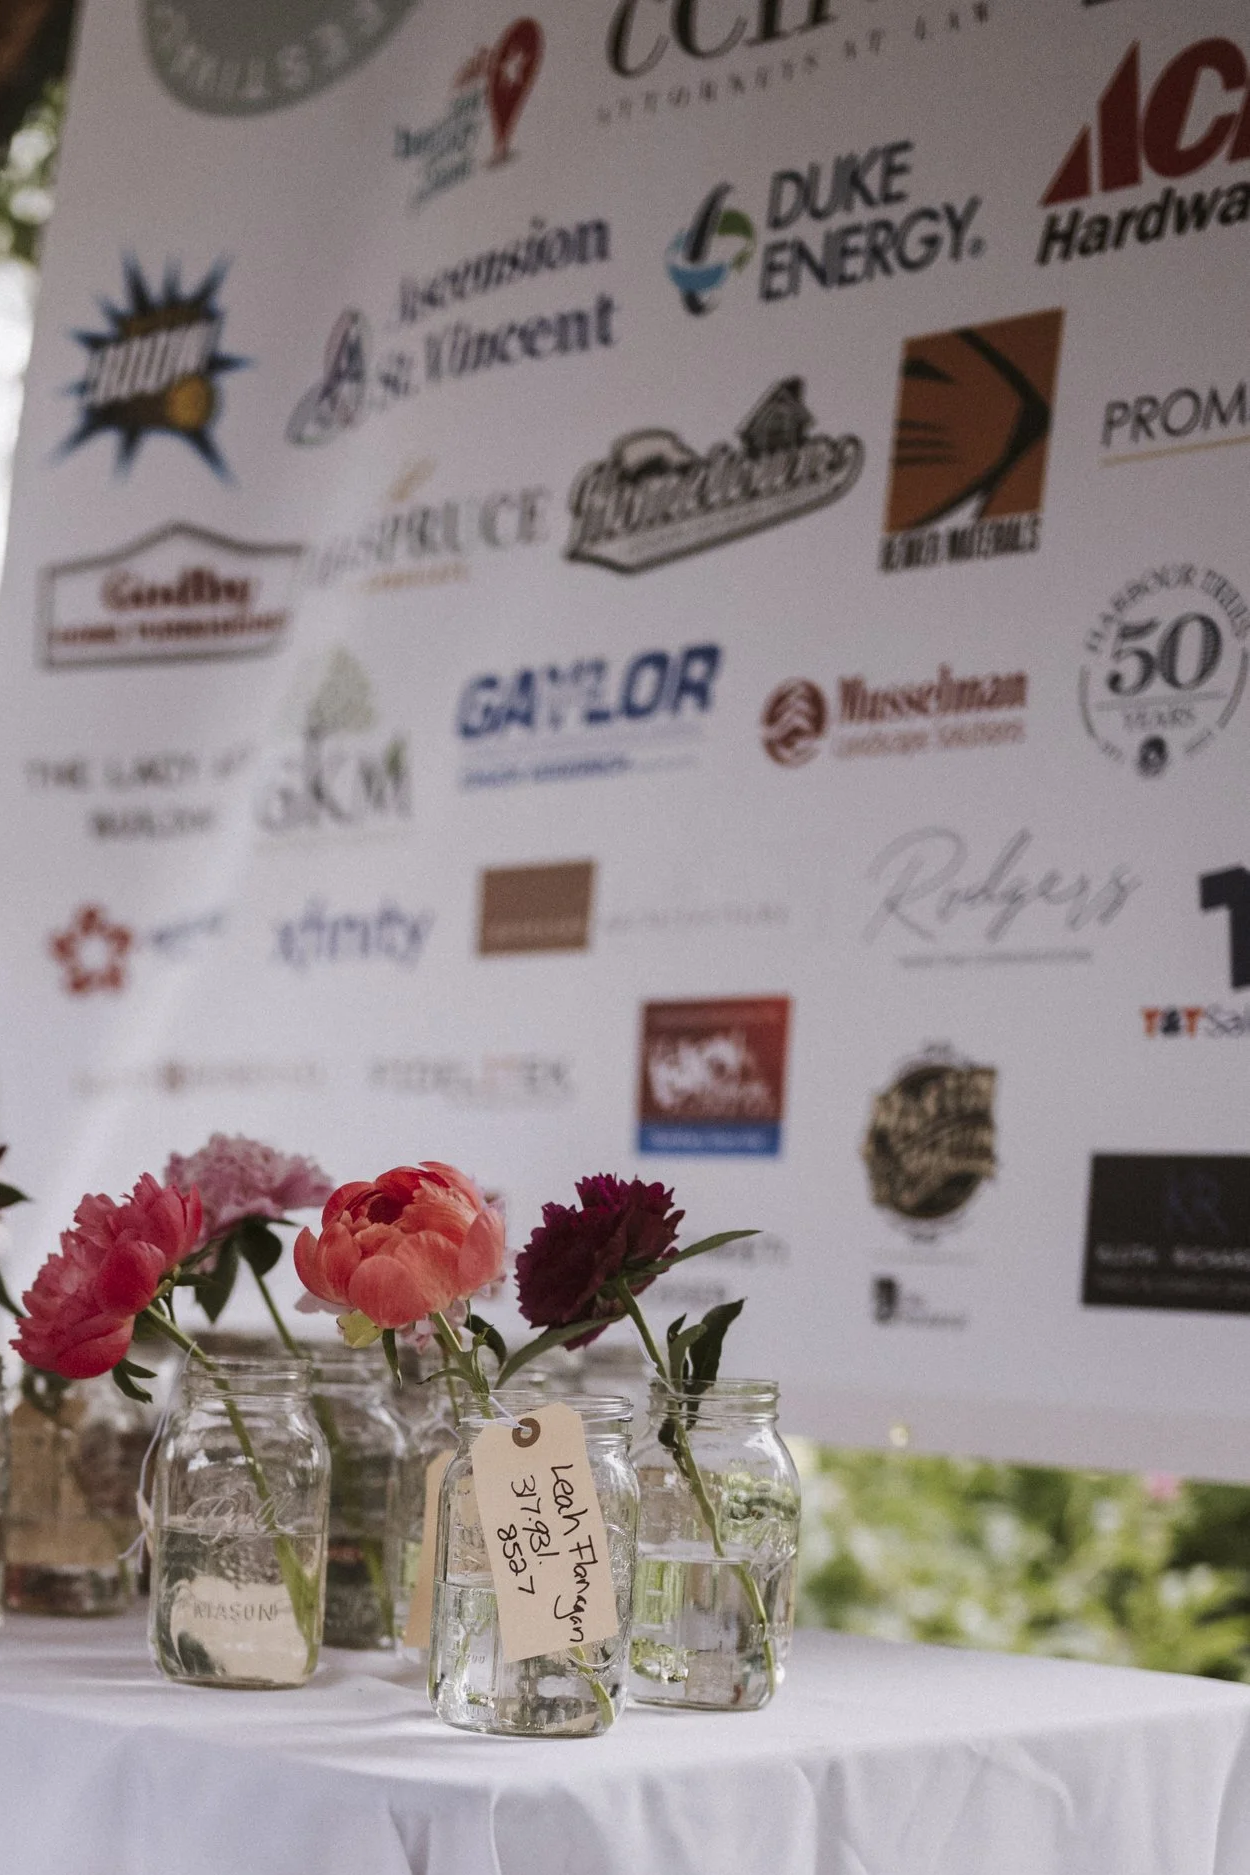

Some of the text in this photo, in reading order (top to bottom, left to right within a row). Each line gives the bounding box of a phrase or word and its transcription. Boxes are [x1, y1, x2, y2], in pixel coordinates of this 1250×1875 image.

[767, 140, 914, 230] DUKE
[425, 292, 618, 385] Vincent
[1101, 380, 1247, 449] PROM
[454, 640, 725, 744] GAYLOR
[1105, 609, 1224, 697] 50
[859, 825, 1144, 946] Rodgers
[496, 1523, 536, 1596] 8527
[550, 1463, 599, 1643] Leah Flanagan
[193, 1600, 279, 1623] MASON
